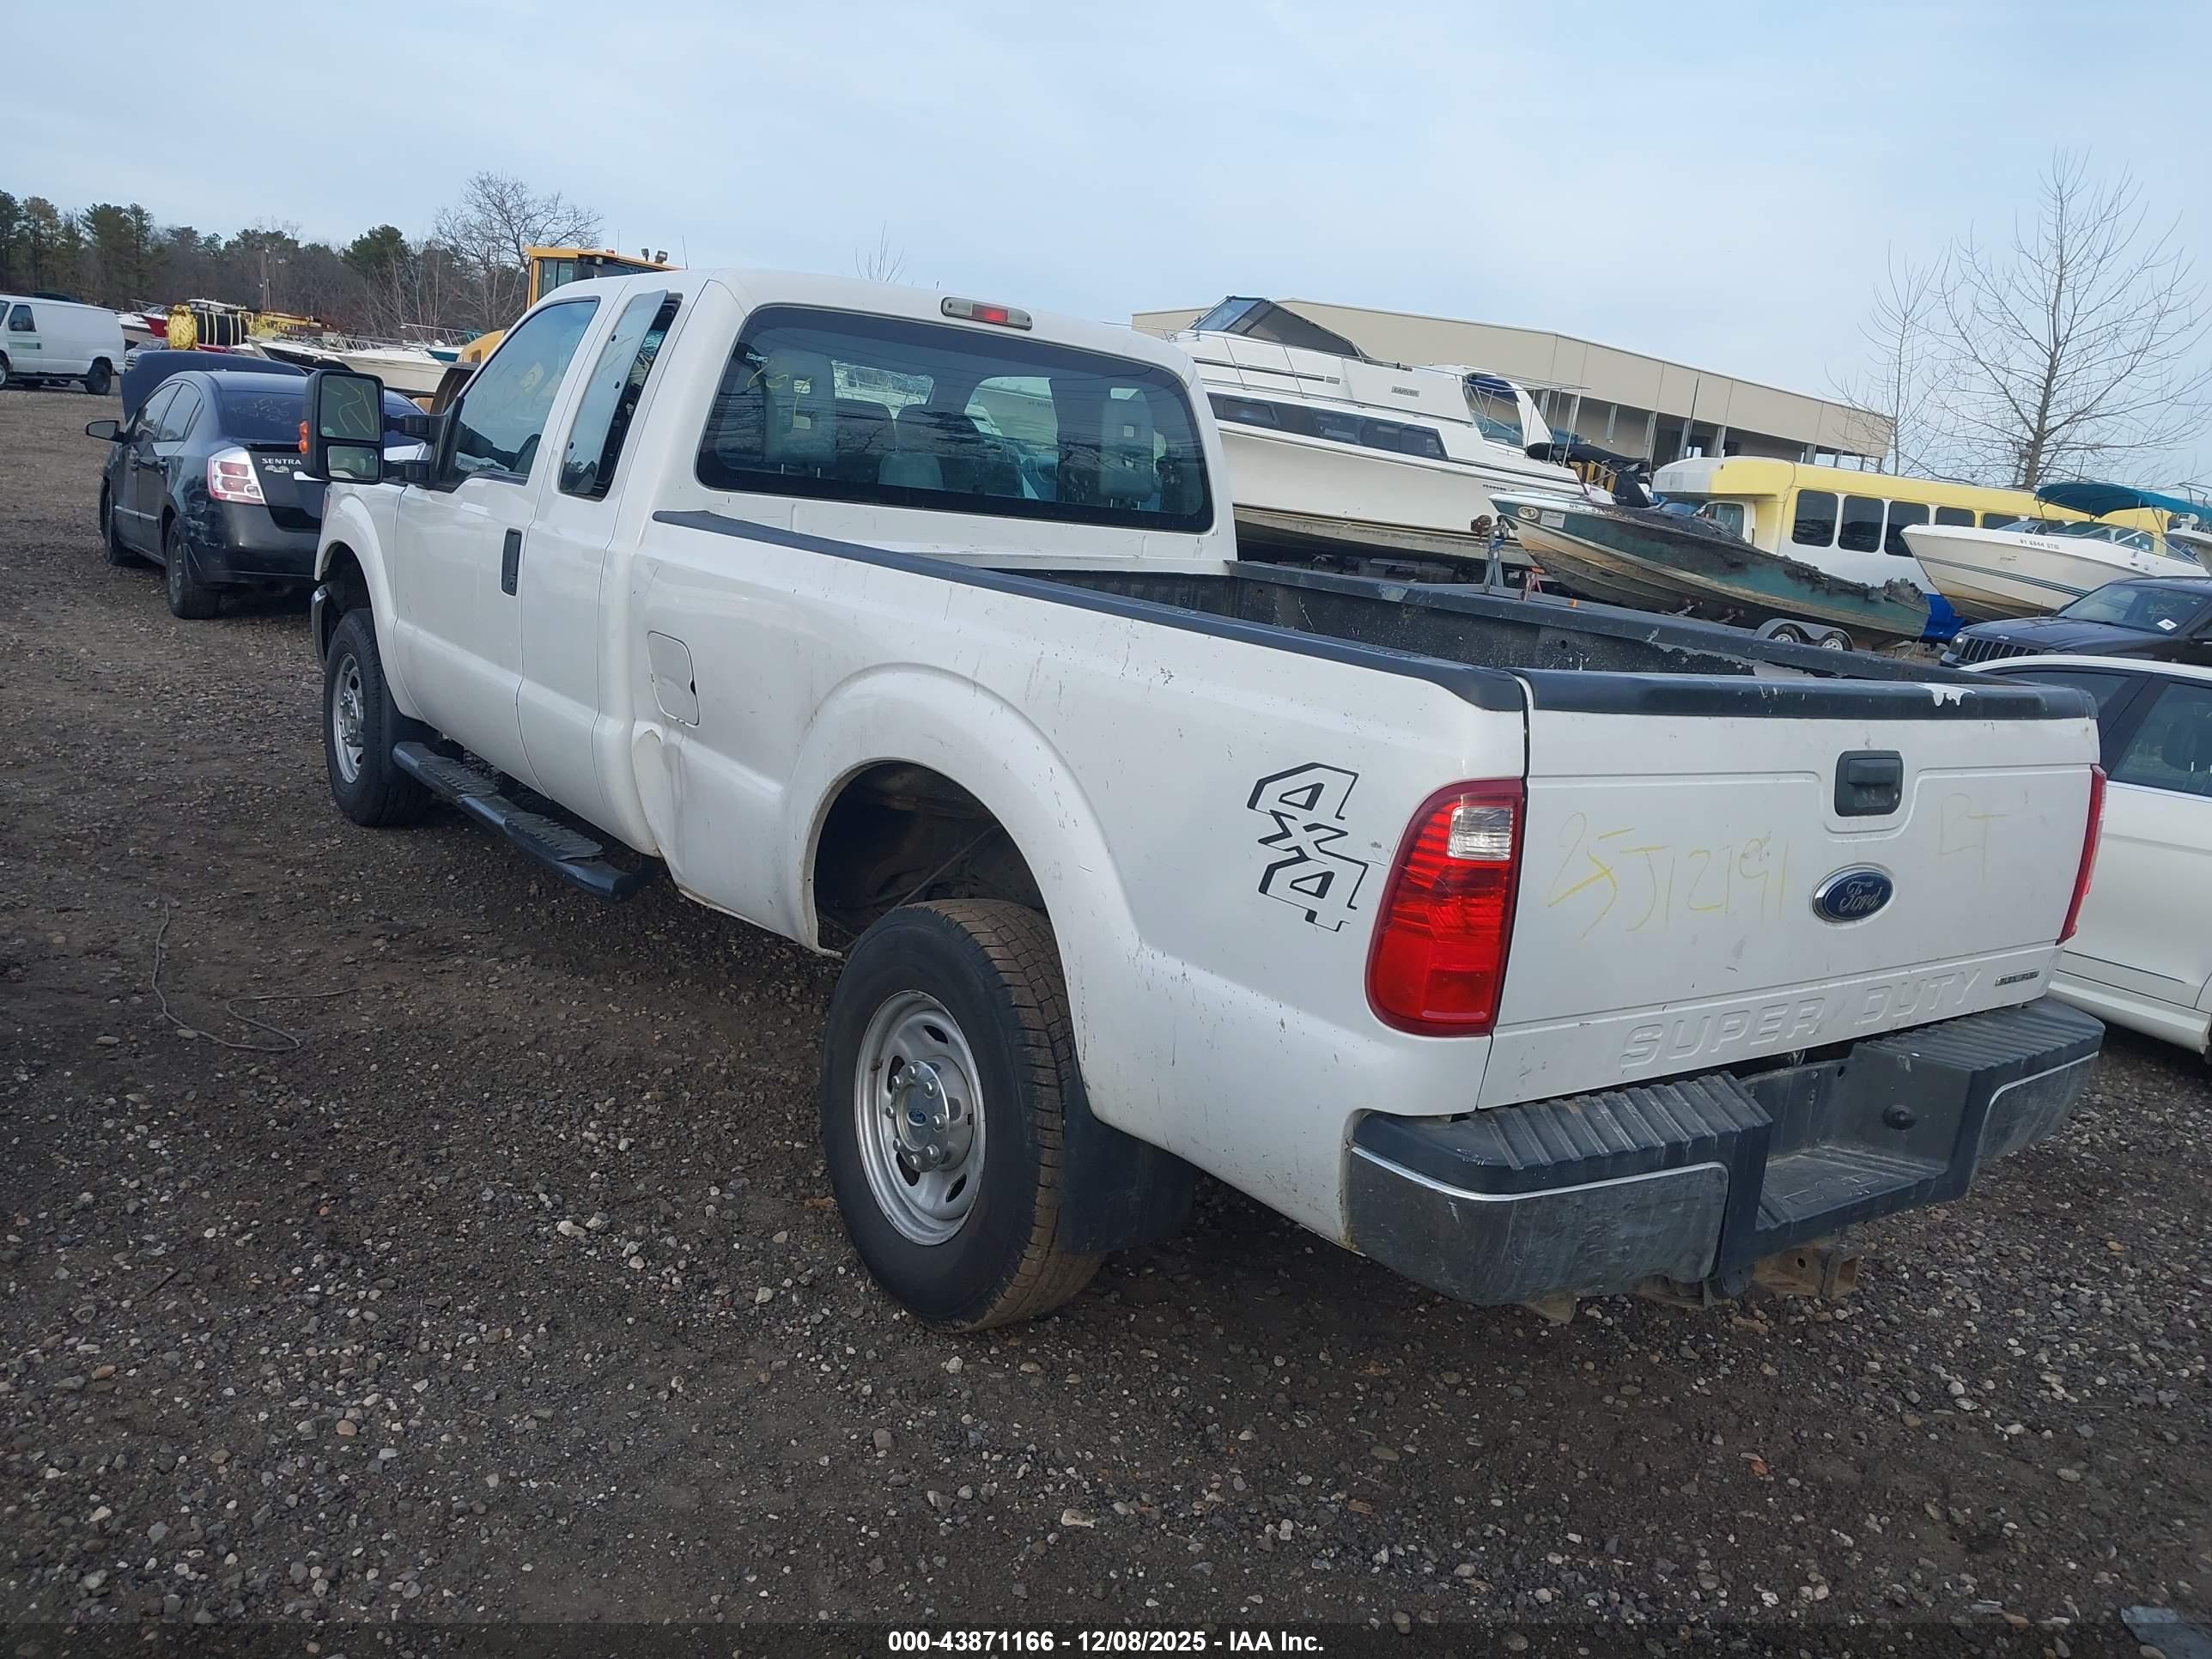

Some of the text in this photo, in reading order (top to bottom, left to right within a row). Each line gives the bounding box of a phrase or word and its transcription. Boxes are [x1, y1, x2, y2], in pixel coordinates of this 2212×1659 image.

[1839, 880, 1883, 913] Ford
[1620, 968, 1982, 1070] SUPER DUTY
